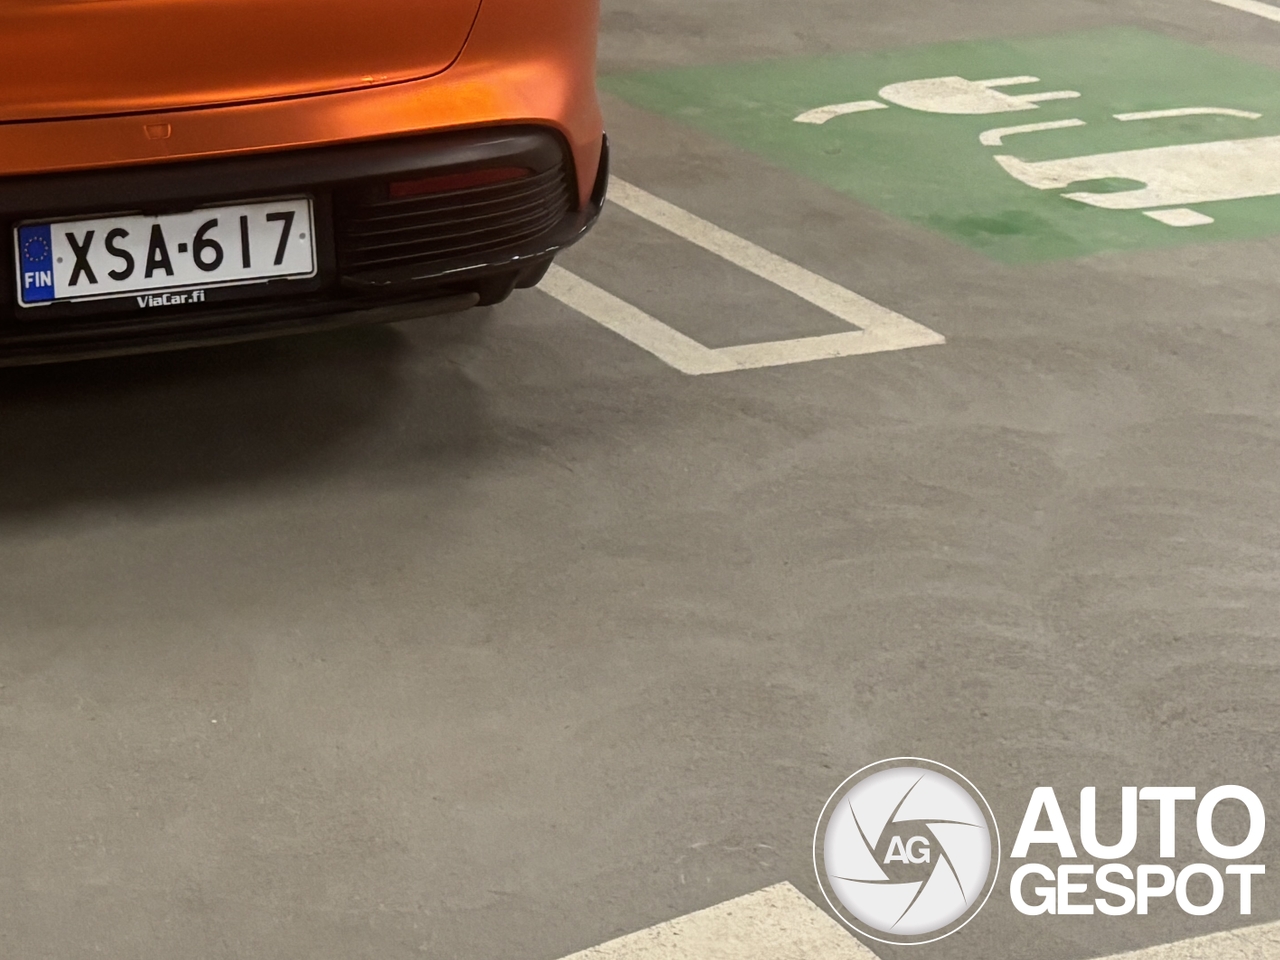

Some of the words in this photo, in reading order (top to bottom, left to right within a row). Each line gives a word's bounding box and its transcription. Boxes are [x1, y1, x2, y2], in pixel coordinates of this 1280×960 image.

[65, 211, 296, 286] XSA-617
[24, 270, 52, 289] FIN
[136, 290, 206, 308] ViaCar.fi
